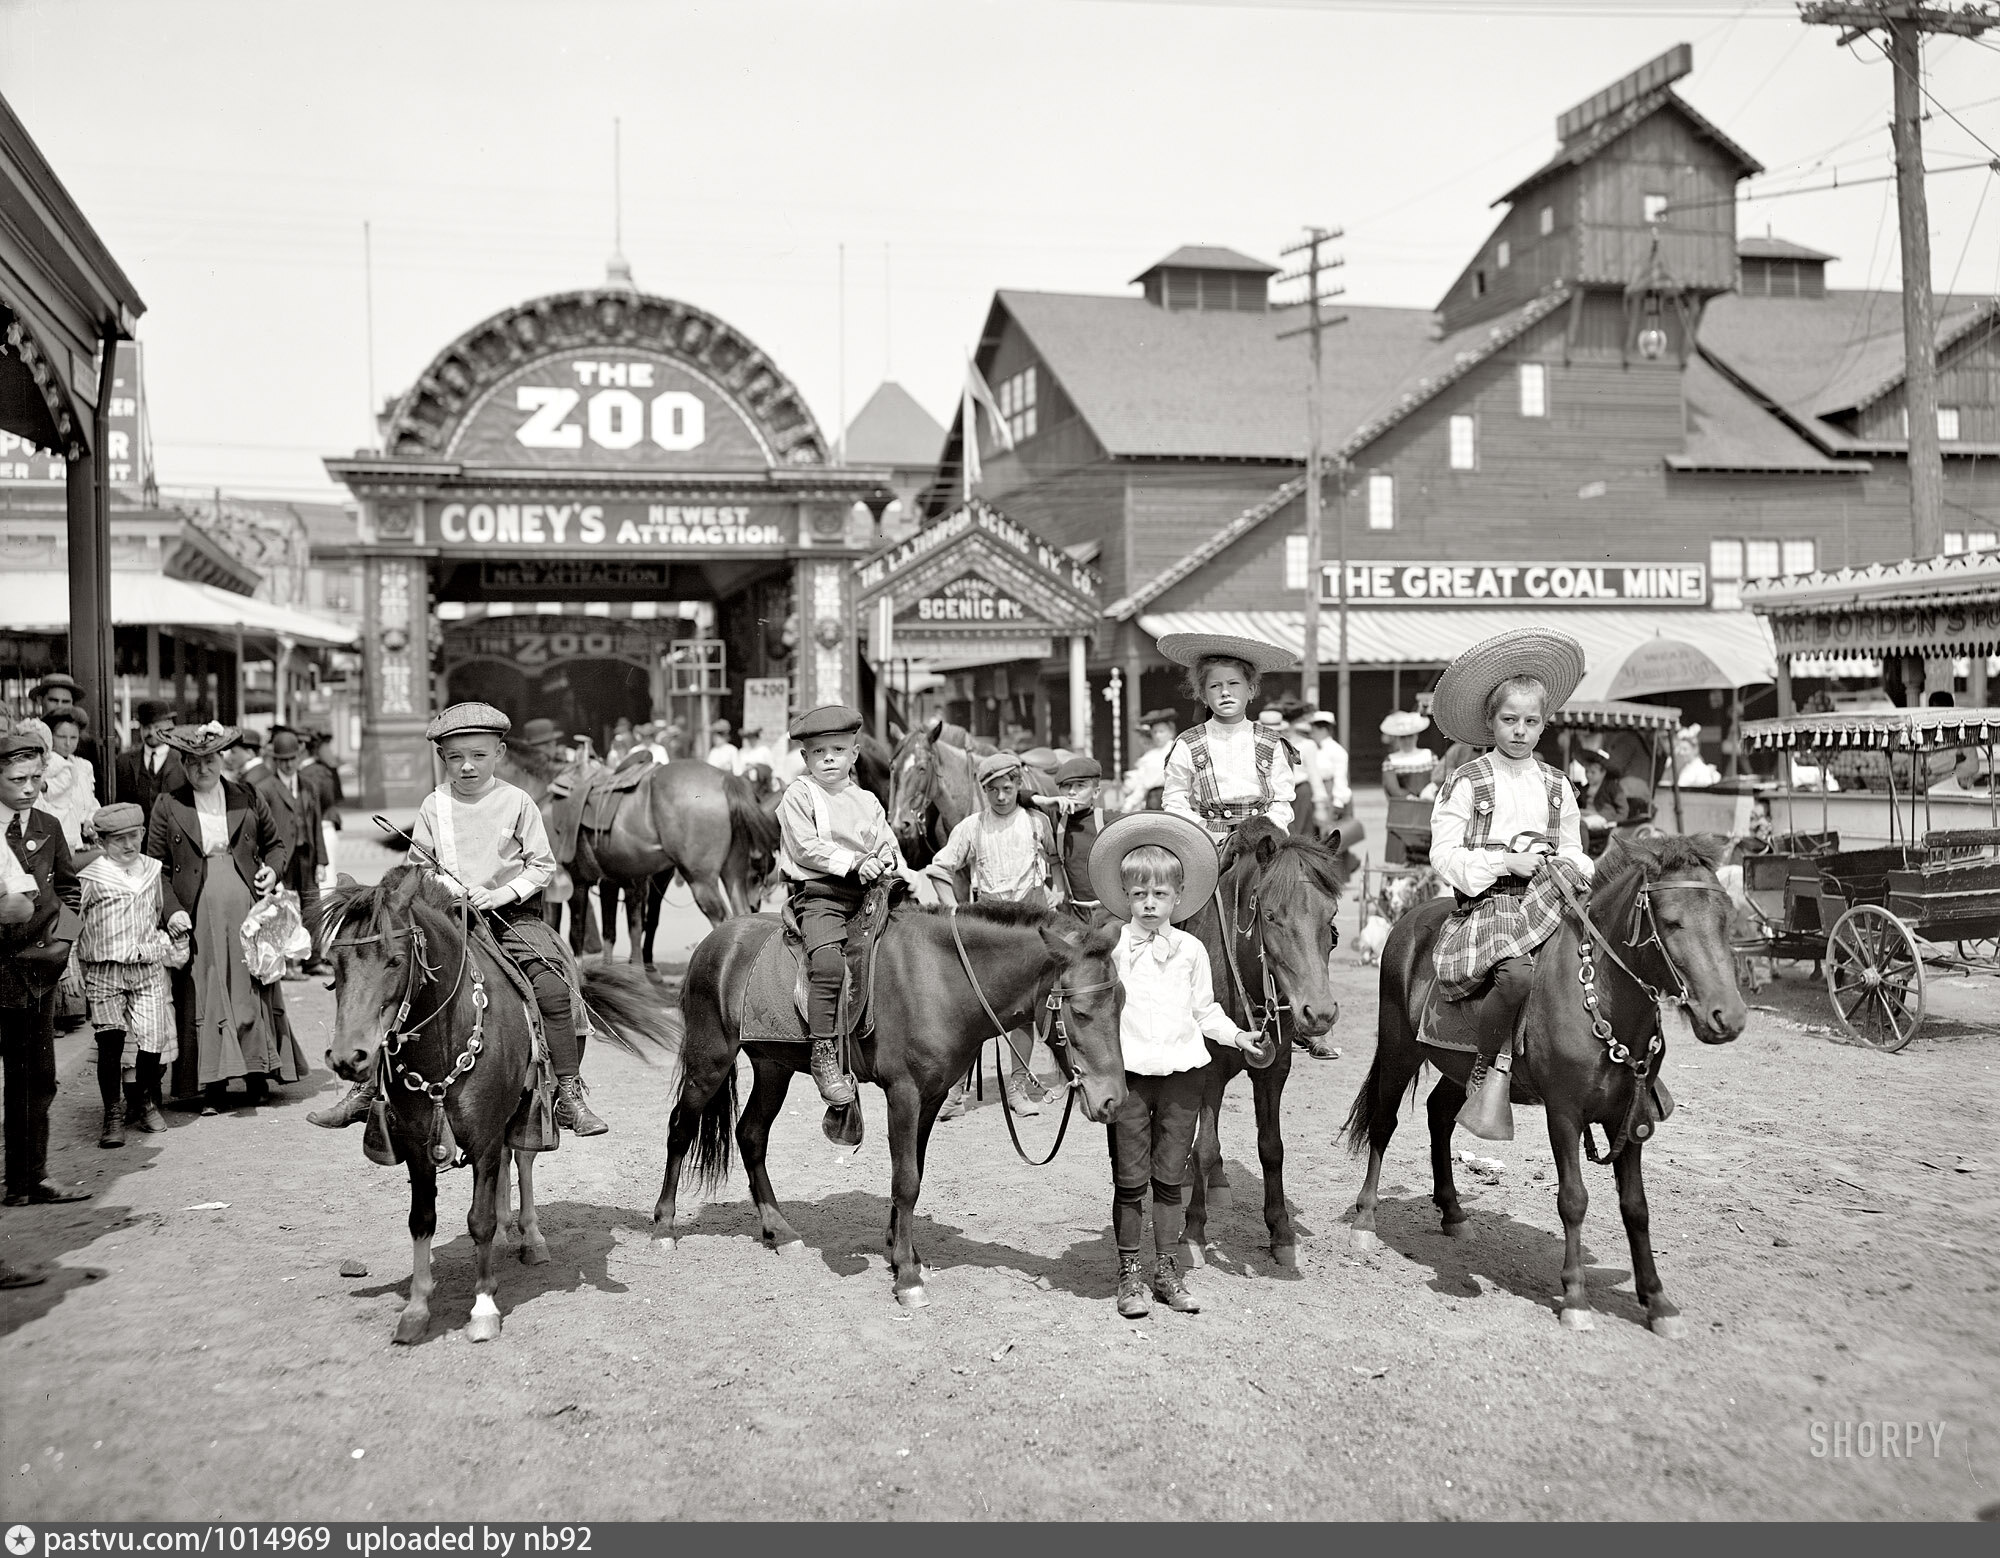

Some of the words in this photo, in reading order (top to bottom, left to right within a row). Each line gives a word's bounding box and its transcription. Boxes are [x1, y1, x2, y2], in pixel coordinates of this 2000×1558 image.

[572, 361, 655, 387] THE
[515, 386, 705, 451] ZOO
[440, 503, 606, 544] CONEY'S
[648, 505, 750, 526] NEWEST
[978, 506, 1030, 554] SCENIC
[616, 519, 786, 544] ATTRACTION.
[858, 559, 885, 588] THE
[1322, 566, 1396, 598] THE
[1401, 566, 1519, 598] GREAT
[1524, 567, 1618, 598] COAL
[1623, 568, 1701, 598] MINE
[918, 598, 994, 619] SCENIC
[1812, 606, 1967, 645] BORDEN'S
[513, 632, 612, 663] ZOO
